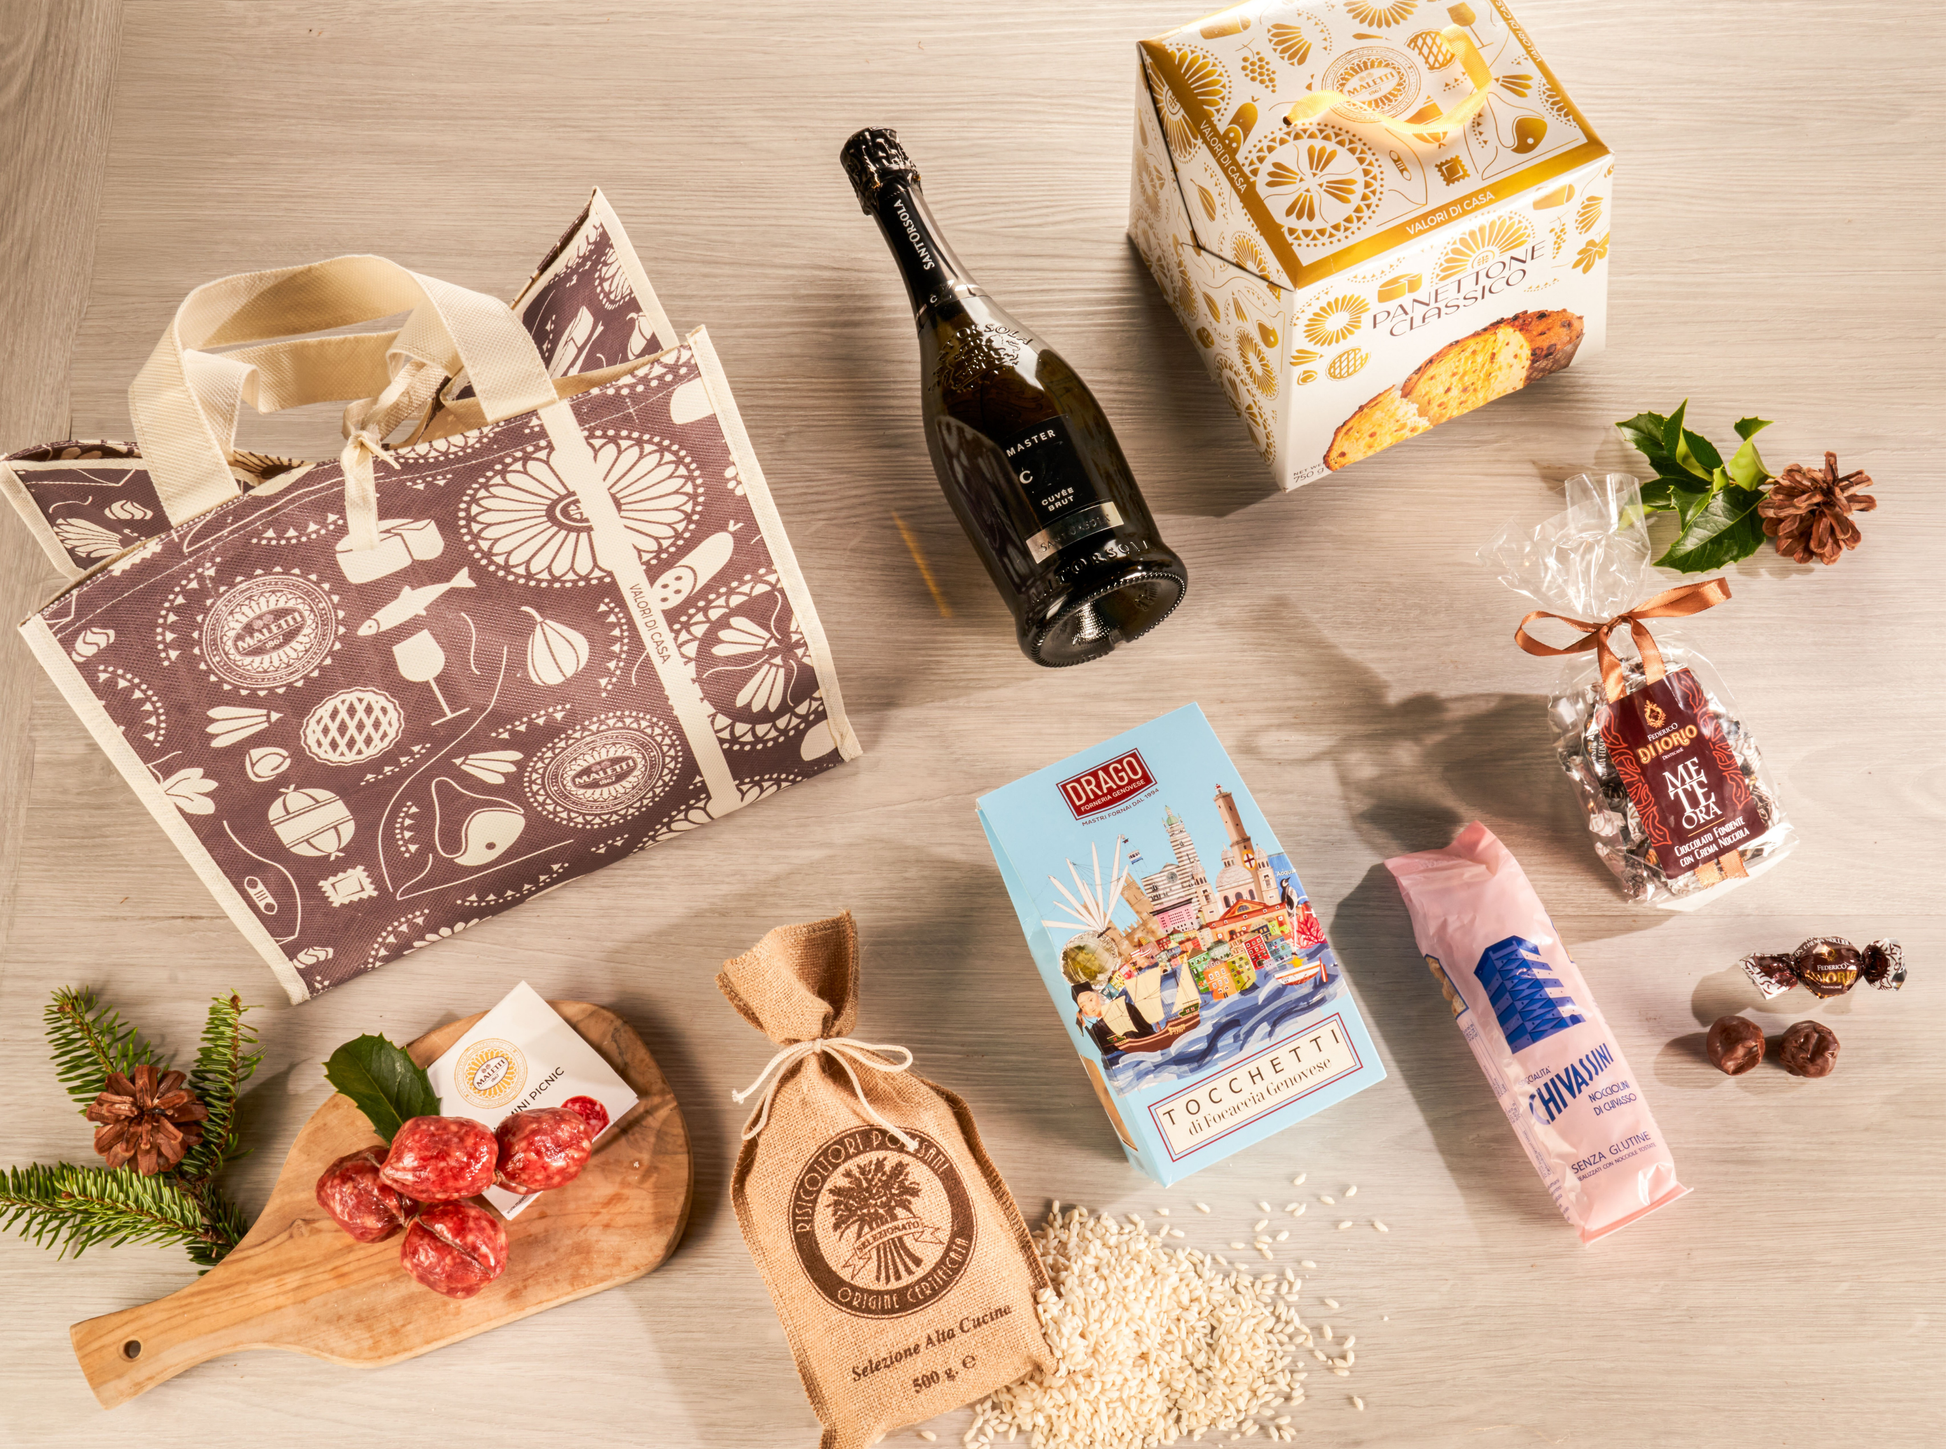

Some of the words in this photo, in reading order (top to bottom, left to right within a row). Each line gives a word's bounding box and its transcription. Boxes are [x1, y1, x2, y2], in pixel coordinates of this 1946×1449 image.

[1495, 0, 1512, 19] CAS
[1346, 71, 1396, 97] MALETTI
[1200, 120, 1225, 160] VALORI
[1220, 154, 1232, 168] DI
[1227, 165, 1247, 194] CASA
[1406, 210, 1449, 235] VALORI
[1449, 204, 1463, 217] DI
[1463, 191, 1496, 211] CASA
[1372, 240, 1547, 330] PANETTONE
[1389, 268, 1527, 338] CLASSICO
[1006, 429, 1056, 457] MASTER
[1293, 471, 1315, 483] 750
[1048, 495, 1074, 512] BRUT
[629, 583, 654, 620] VALORI
[236, 612, 302, 651] MALETTI
[265, 635, 284, 650] 1867
[644, 619, 659, 632] DI
[650, 631, 672, 665] CASA
[1636, 743, 1658, 765] DI
[1653, 723, 1699, 756] IORIO
[1646, 721, 1679, 742] FEDERICO
[574, 757, 636, 785] MALETTI
[1065, 756, 1143, 806] DRAGO
[1662, 756, 1705, 794] ME
[1080, 794, 1113, 813] FORNERIA
[1111, 778, 1147, 798] GENOVESE
[1081, 814, 1107, 827] MASTRI
[1107, 804, 1133, 819] FORNAI
[1131, 796, 1145, 807] DAL
[1143, 787, 1160, 799] 1994
[1668, 769, 1717, 816] TE
[1681, 800, 1723, 830] ORA
[1713, 815, 1746, 838] FONDENTE
[1694, 844, 1719, 860] CREMA
[1717, 826, 1751, 850] NOCCIOLA
[1817, 962, 1848, 972] FEDERICO
[476, 1058, 506, 1088] MALETTI
[529, 1066, 565, 1101] PICNIC
[1162, 1028, 1341, 1127] TOCCHETTI
[1528, 1042, 1615, 1126] CHIVASSINI
[1188, 1118, 1204, 1137] di
[1204, 1091, 1266, 1129] Focaccia
[1266, 1057, 1333, 1097] Genovese
[1593, 1105, 1604, 1117] DI
[1602, 1092, 1638, 1112] CHIVASSO
[1571, 1151, 1607, 1175] SENZA
[1608, 1130, 1651, 1156] GLUTINE
[1602, 1160, 1614, 1170] CON
[795, 1134, 863, 1233] RISICOLTORI
[856, 1220, 920, 1252] SELEZIONATO
[837, 1287, 900, 1310] ORIGINE
[907, 1237, 969, 1303] CERTIFICATA
[851, 1343, 921, 1383] Selezione
[925, 1328, 956, 1350] Alta
[958, 1304, 1012, 1334] Cucina
[912, 1370, 941, 1394] 500
[944, 1367, 959, 1382] g.
